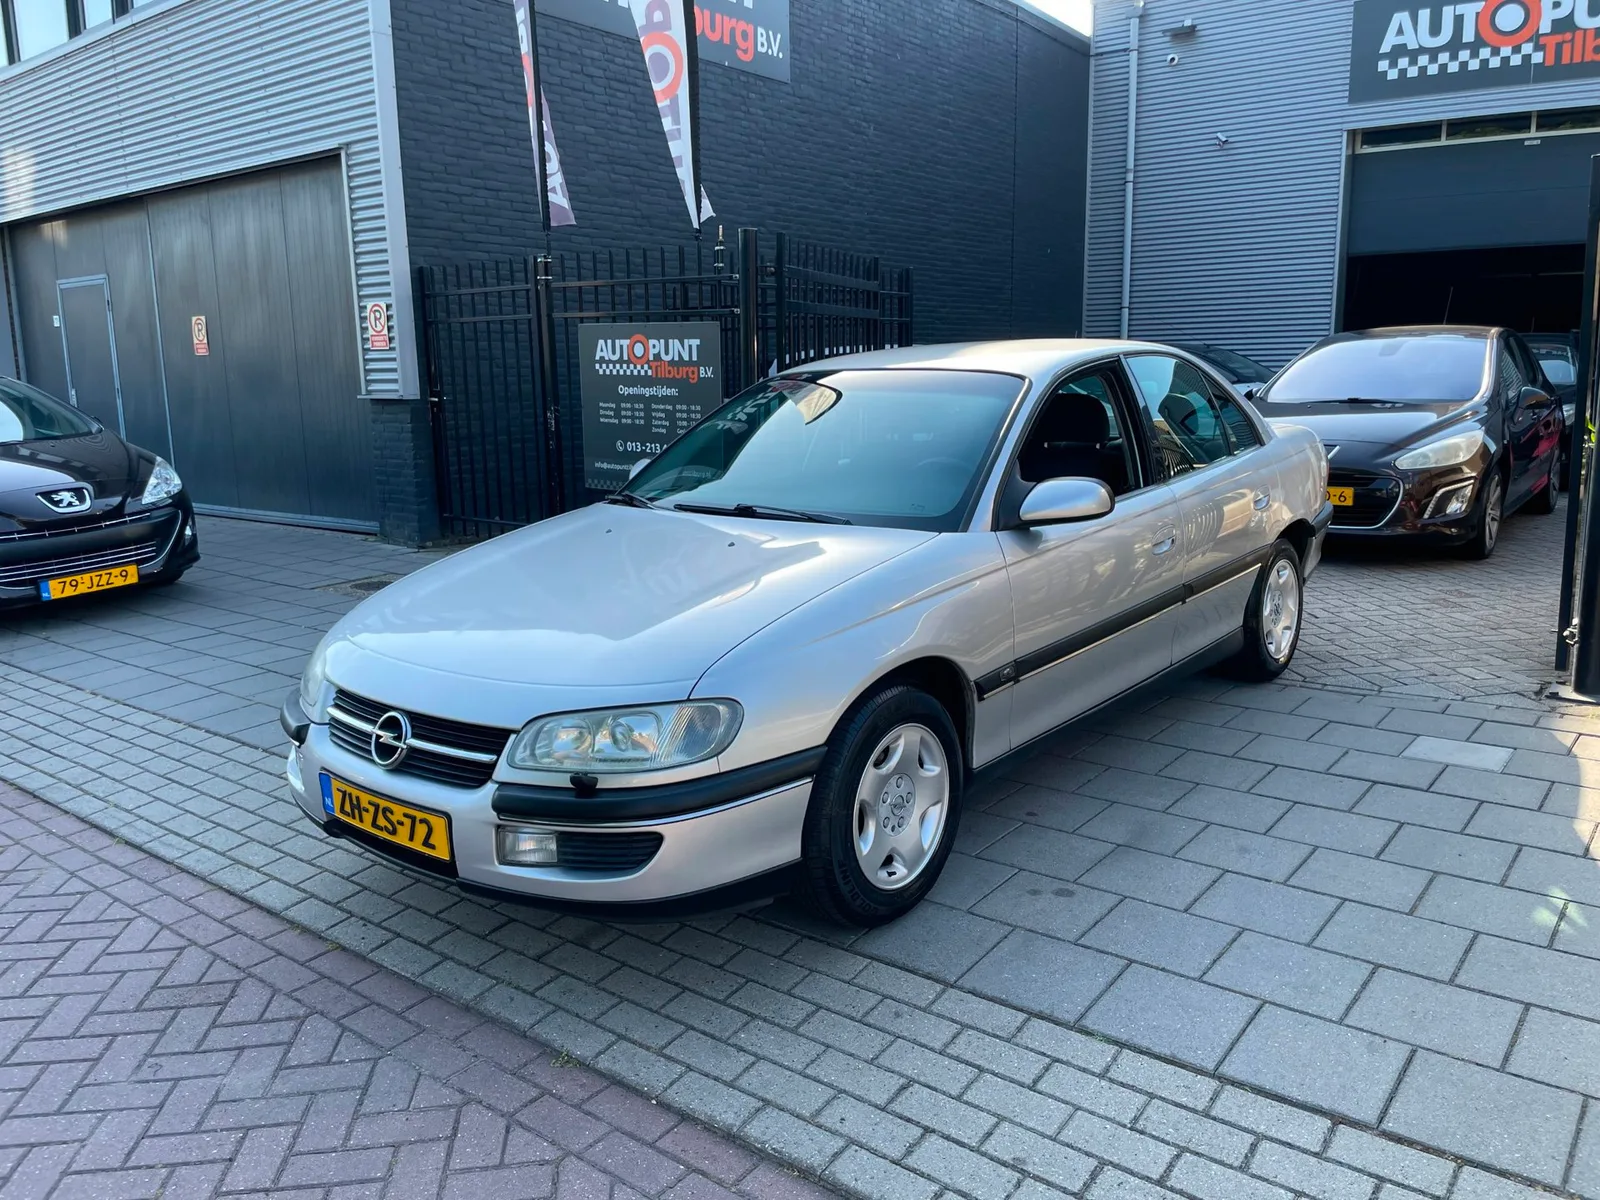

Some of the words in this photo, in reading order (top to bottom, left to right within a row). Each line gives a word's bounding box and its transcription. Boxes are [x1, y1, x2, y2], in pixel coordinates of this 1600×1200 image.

[757, 26, 783, 59] B.V.
[595, 333, 700, 365] AUTOPUNT
[649, 361, 698, 384] Tilburg
[699, 366, 714, 378] B.V.
[618, 384, 679, 397] Openingstijden:
[57, 569, 129, 594] 79-JZZ-9
[336, 786, 437, 851] ZH-ZS-72
